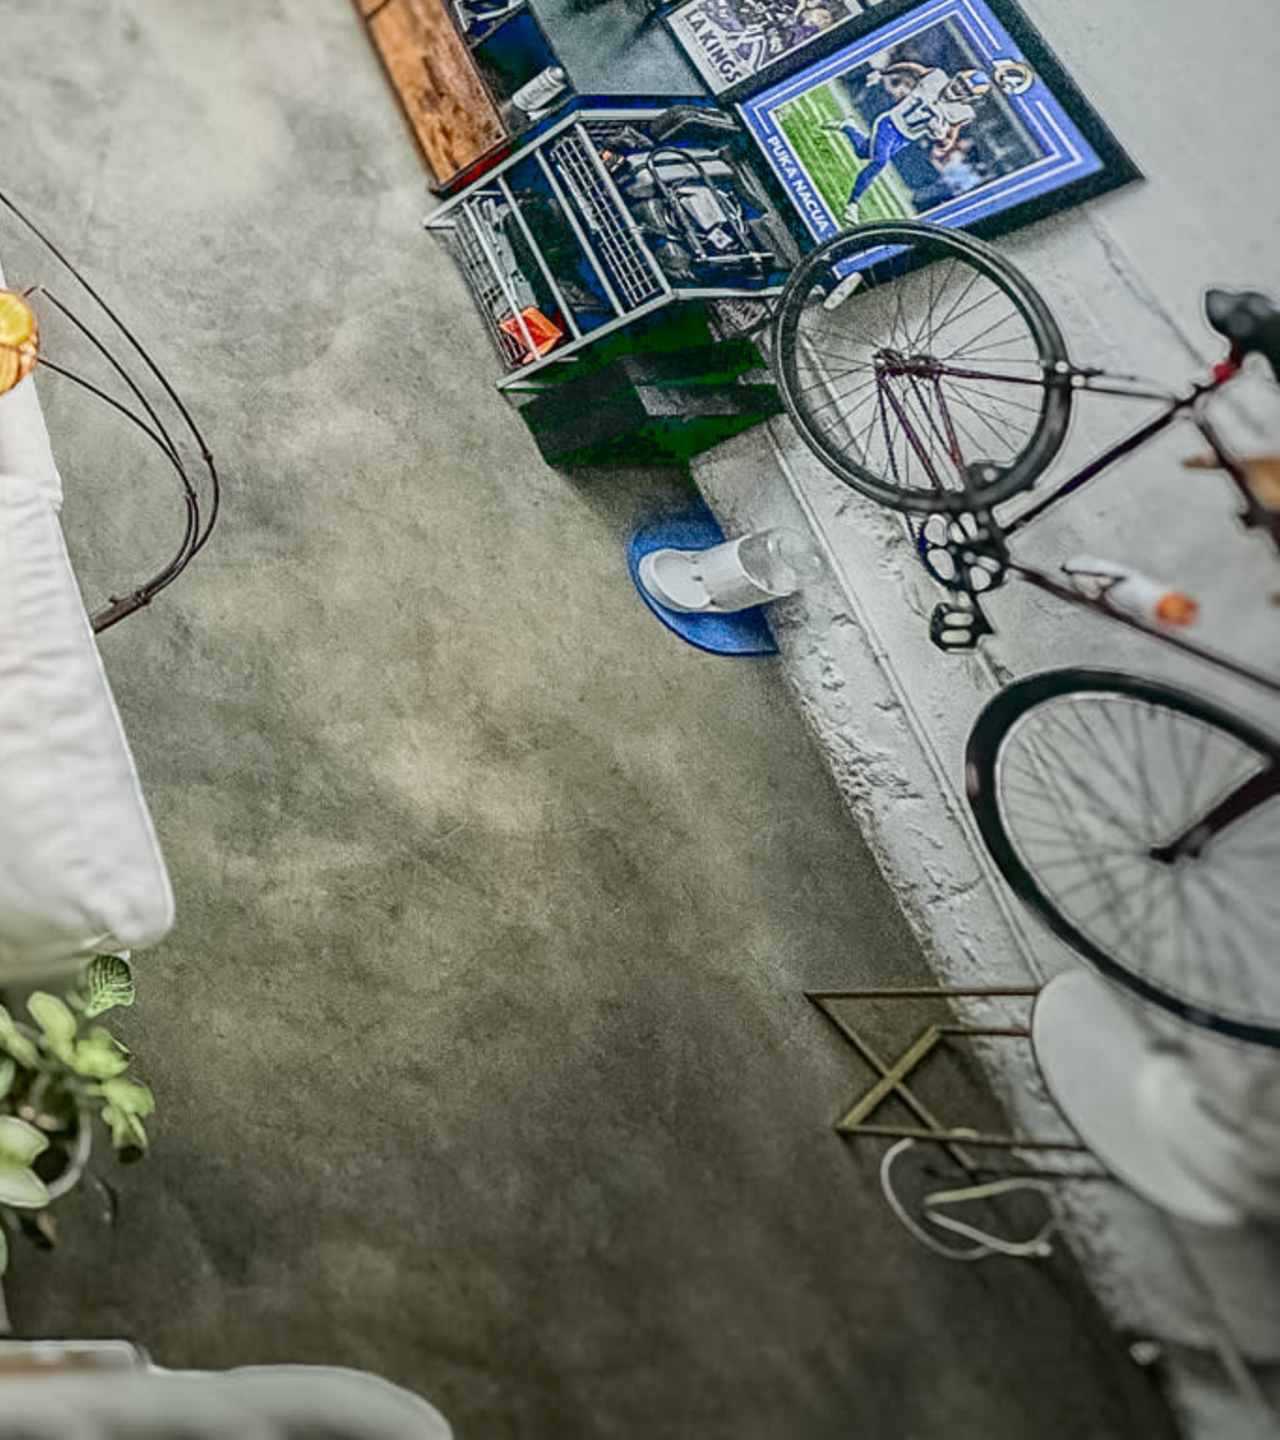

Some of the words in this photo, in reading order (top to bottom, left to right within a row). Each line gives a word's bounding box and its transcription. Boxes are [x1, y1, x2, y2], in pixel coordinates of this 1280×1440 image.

[684, 9, 706, 33] LA
[699, 30, 742, 83] KINGS
[902, 97, 937, 128] 17
[767, 135, 797, 179] PUKA
[792, 179, 829, 232] NACUA
